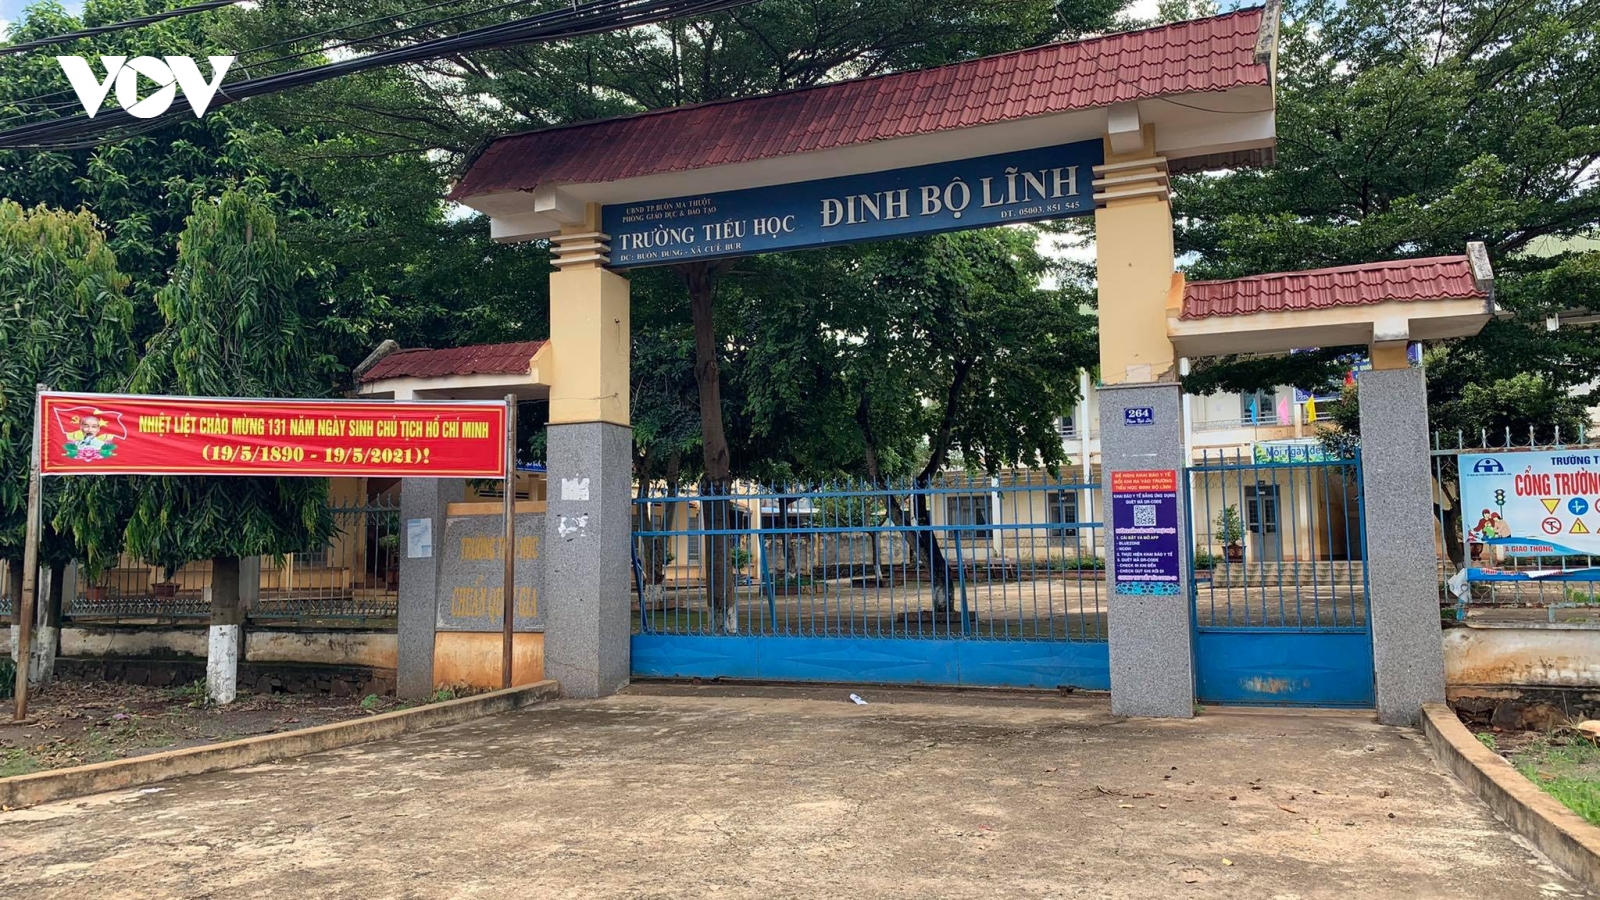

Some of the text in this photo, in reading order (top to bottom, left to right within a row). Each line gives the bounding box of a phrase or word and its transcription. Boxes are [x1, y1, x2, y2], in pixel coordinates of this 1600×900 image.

[626, 206, 645, 215] UBND
[675, 202, 687, 210] MA
[688, 197, 712, 209] THUỘT
[821, 165, 1080, 228] ĐINH BỘ LĨNH
[1065, 200, 1081, 210] 545
[646, 210, 663, 221] GIÁO
[665, 210, 678, 220] DỤC
[679, 209, 685, 217] &
[703, 205, 717, 216] TẠO
[619, 214, 796, 251] TRƯỜNG TIỂU HỌC
[690, 244, 702, 255] XÃ
[725, 241, 742, 251] BUR
[1128, 409, 1149, 418] 264
[139, 412, 489, 441] NHIỆT LIỆT CHÀO MỪNG 131 NĂM NGÀY SINH CHỦ TỊCH HỒ CHÍ MINH
[202, 444, 304, 463] (19/5/1890
[324, 447, 430, 465] 19/5/2021)!
[1515, 465, 1600, 496] CỔNG TRƯỜN
